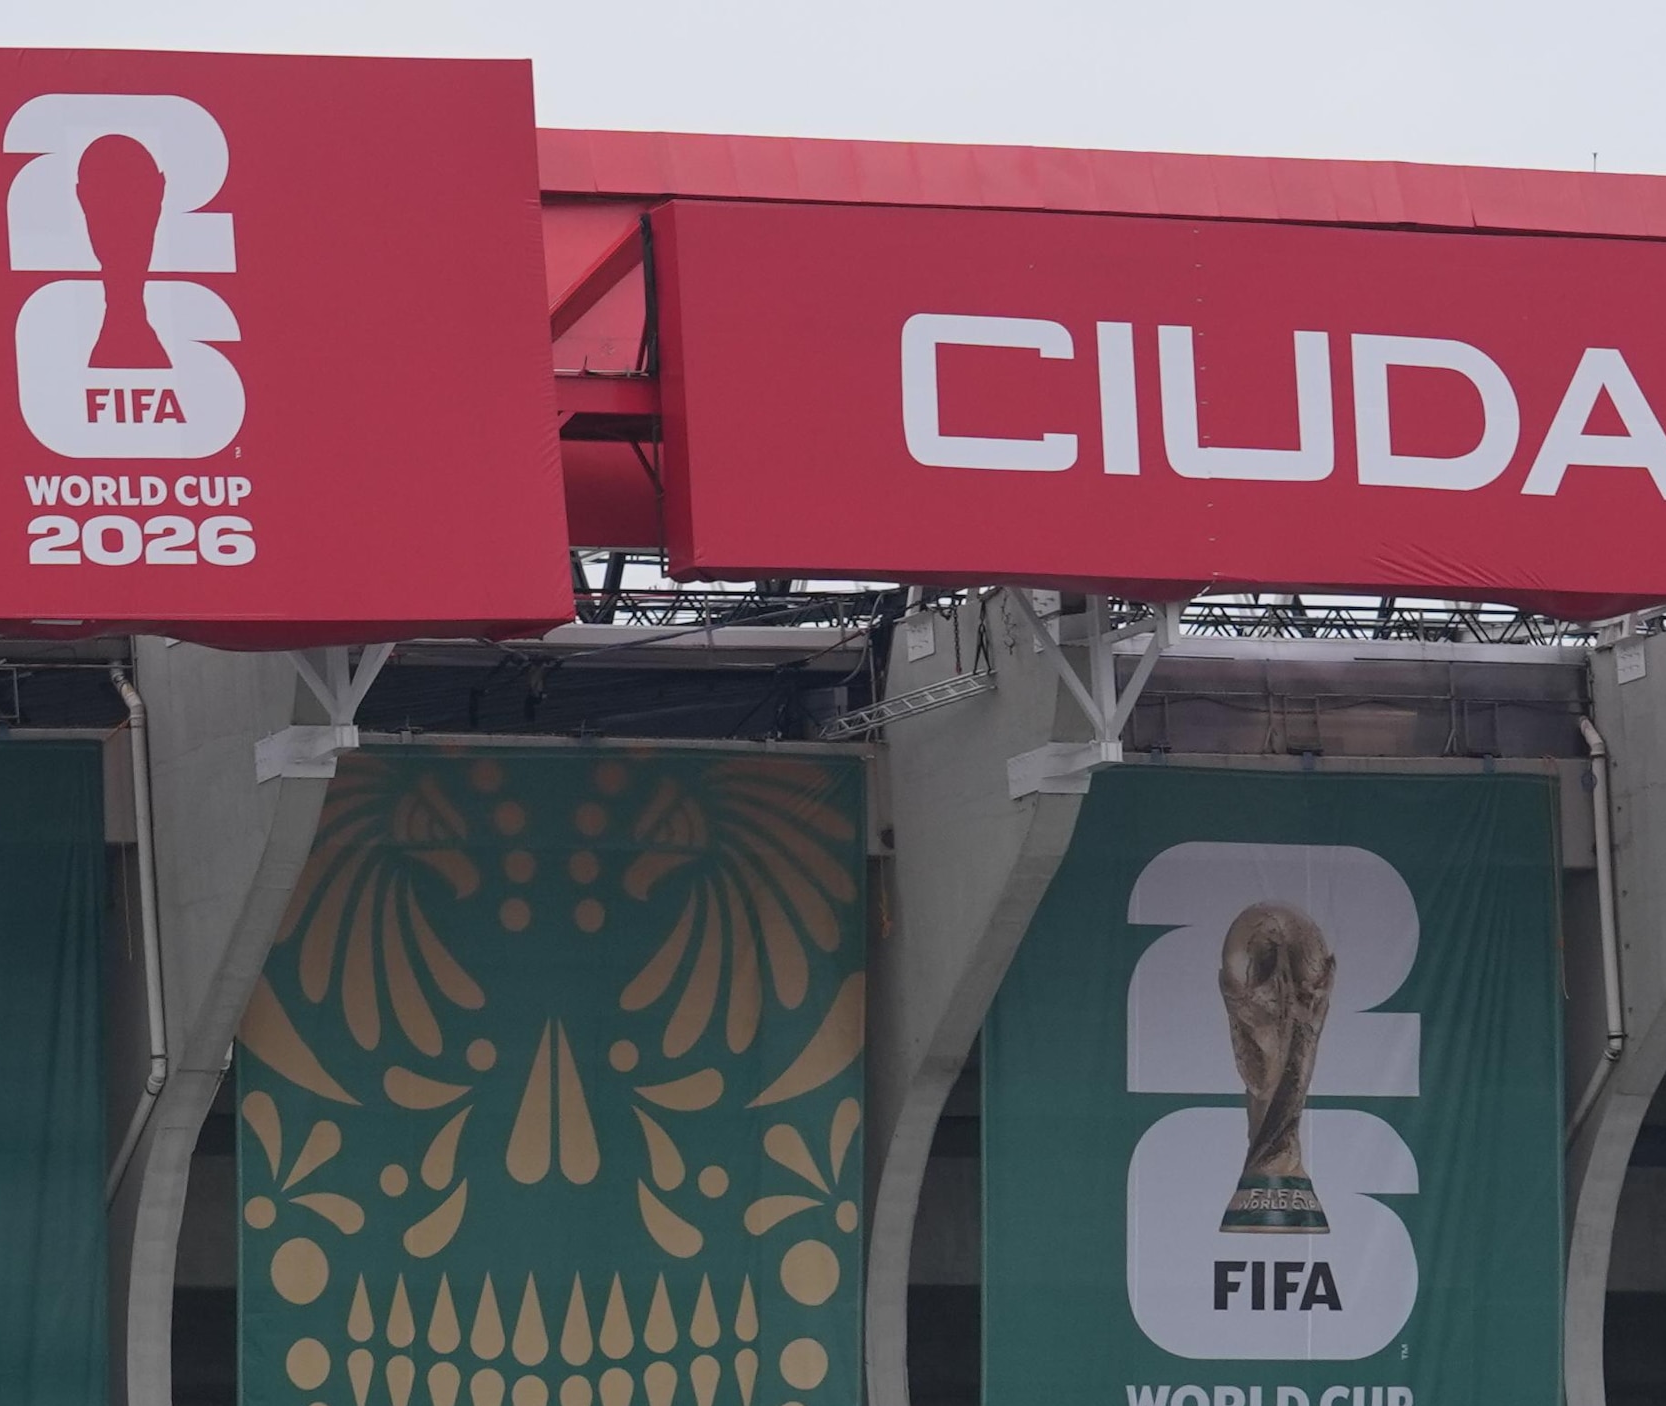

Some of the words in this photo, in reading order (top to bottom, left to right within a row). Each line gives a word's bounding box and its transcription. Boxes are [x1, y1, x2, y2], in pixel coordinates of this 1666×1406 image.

[85, 388, 187, 425] FIFA
[24, 475, 168, 507] WORLD
[174, 475, 252, 507] CUP
[28, 515, 257, 567] 2026
[1239, 1199, 1287, 1209] WORLD
[1250, 1188, 1306, 1199] FIFA
[1214, 1260, 1343, 1311] FIFA
